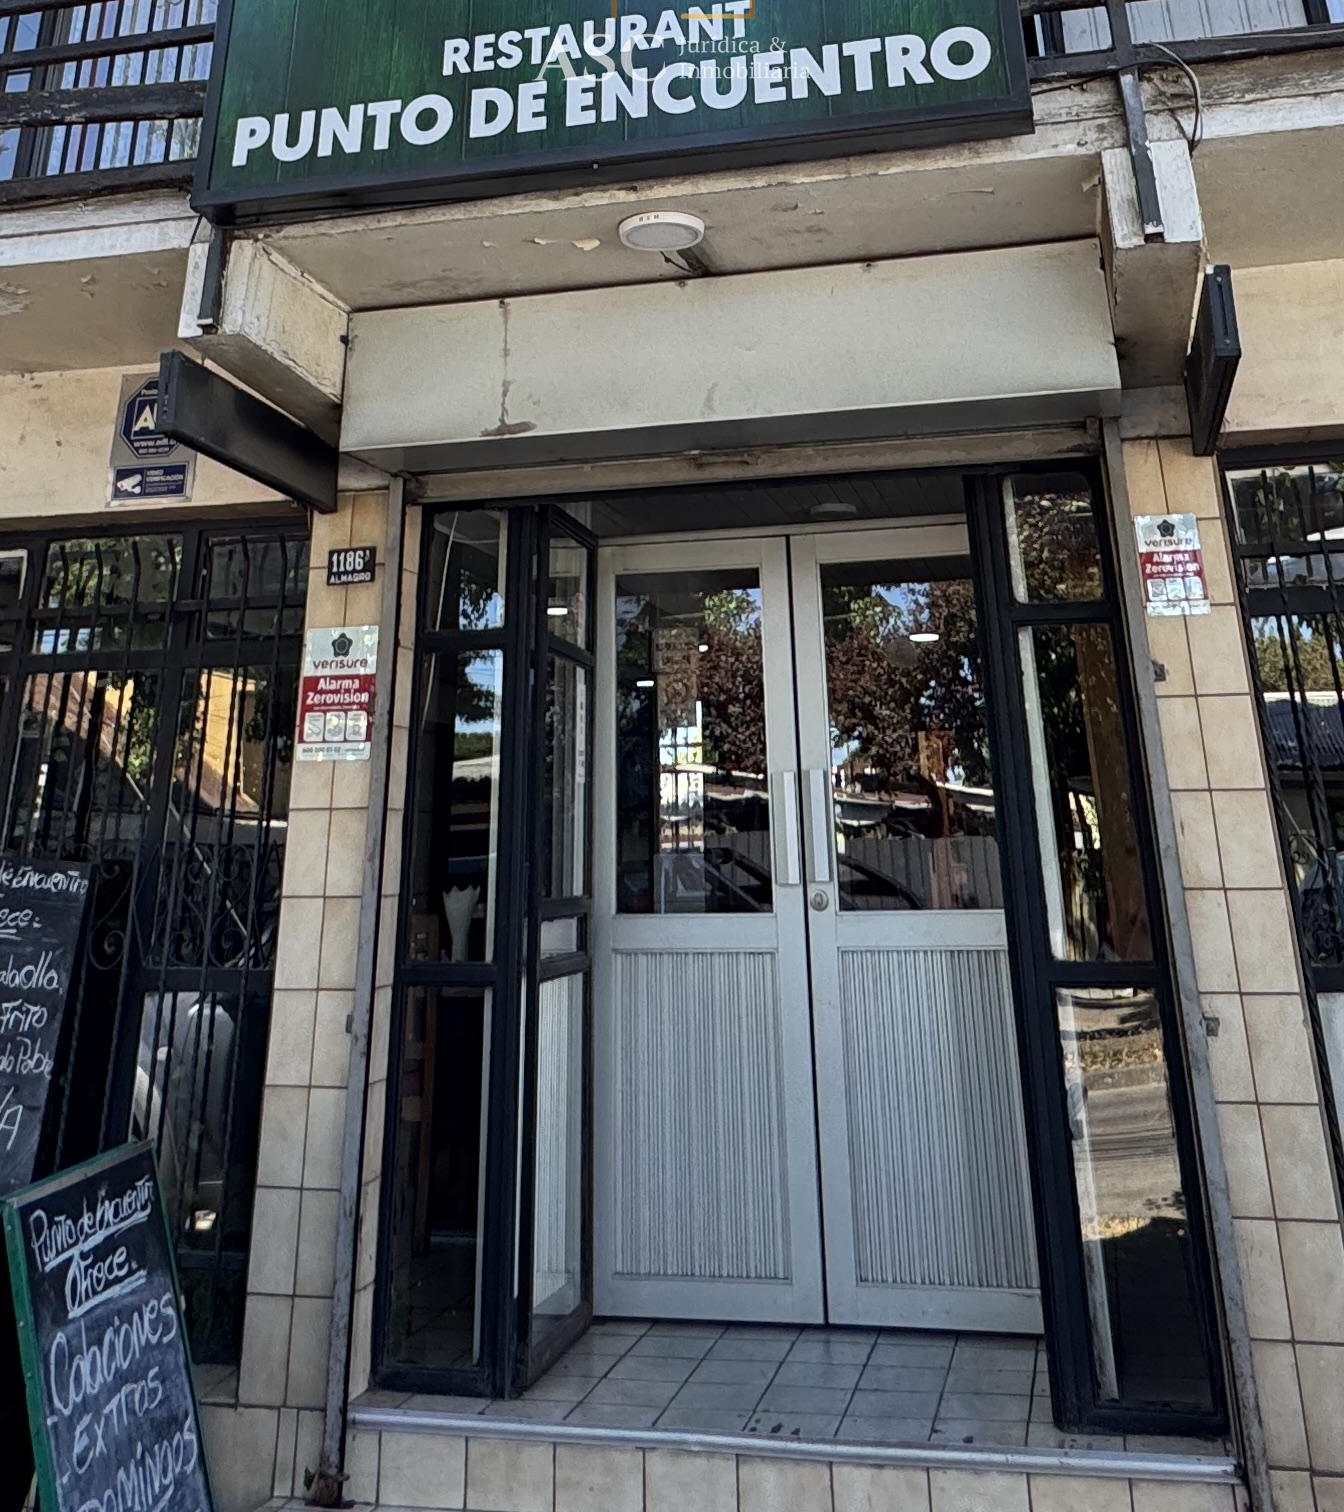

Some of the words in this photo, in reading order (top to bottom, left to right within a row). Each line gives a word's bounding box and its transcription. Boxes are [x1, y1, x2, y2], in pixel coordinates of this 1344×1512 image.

[442, 0, 752, 76] RESTAURANT
[232, 94, 454, 167] PUNTO
[469, 80, 548, 138] DE
[564, 26, 992, 127] ENCUENTRO
[330, 572, 371, 583] ALMAGRO
[313, 658, 368, 669] verisure
[317, 676, 360, 691] Alarma
[306, 689, 369, 705] Zerovision
